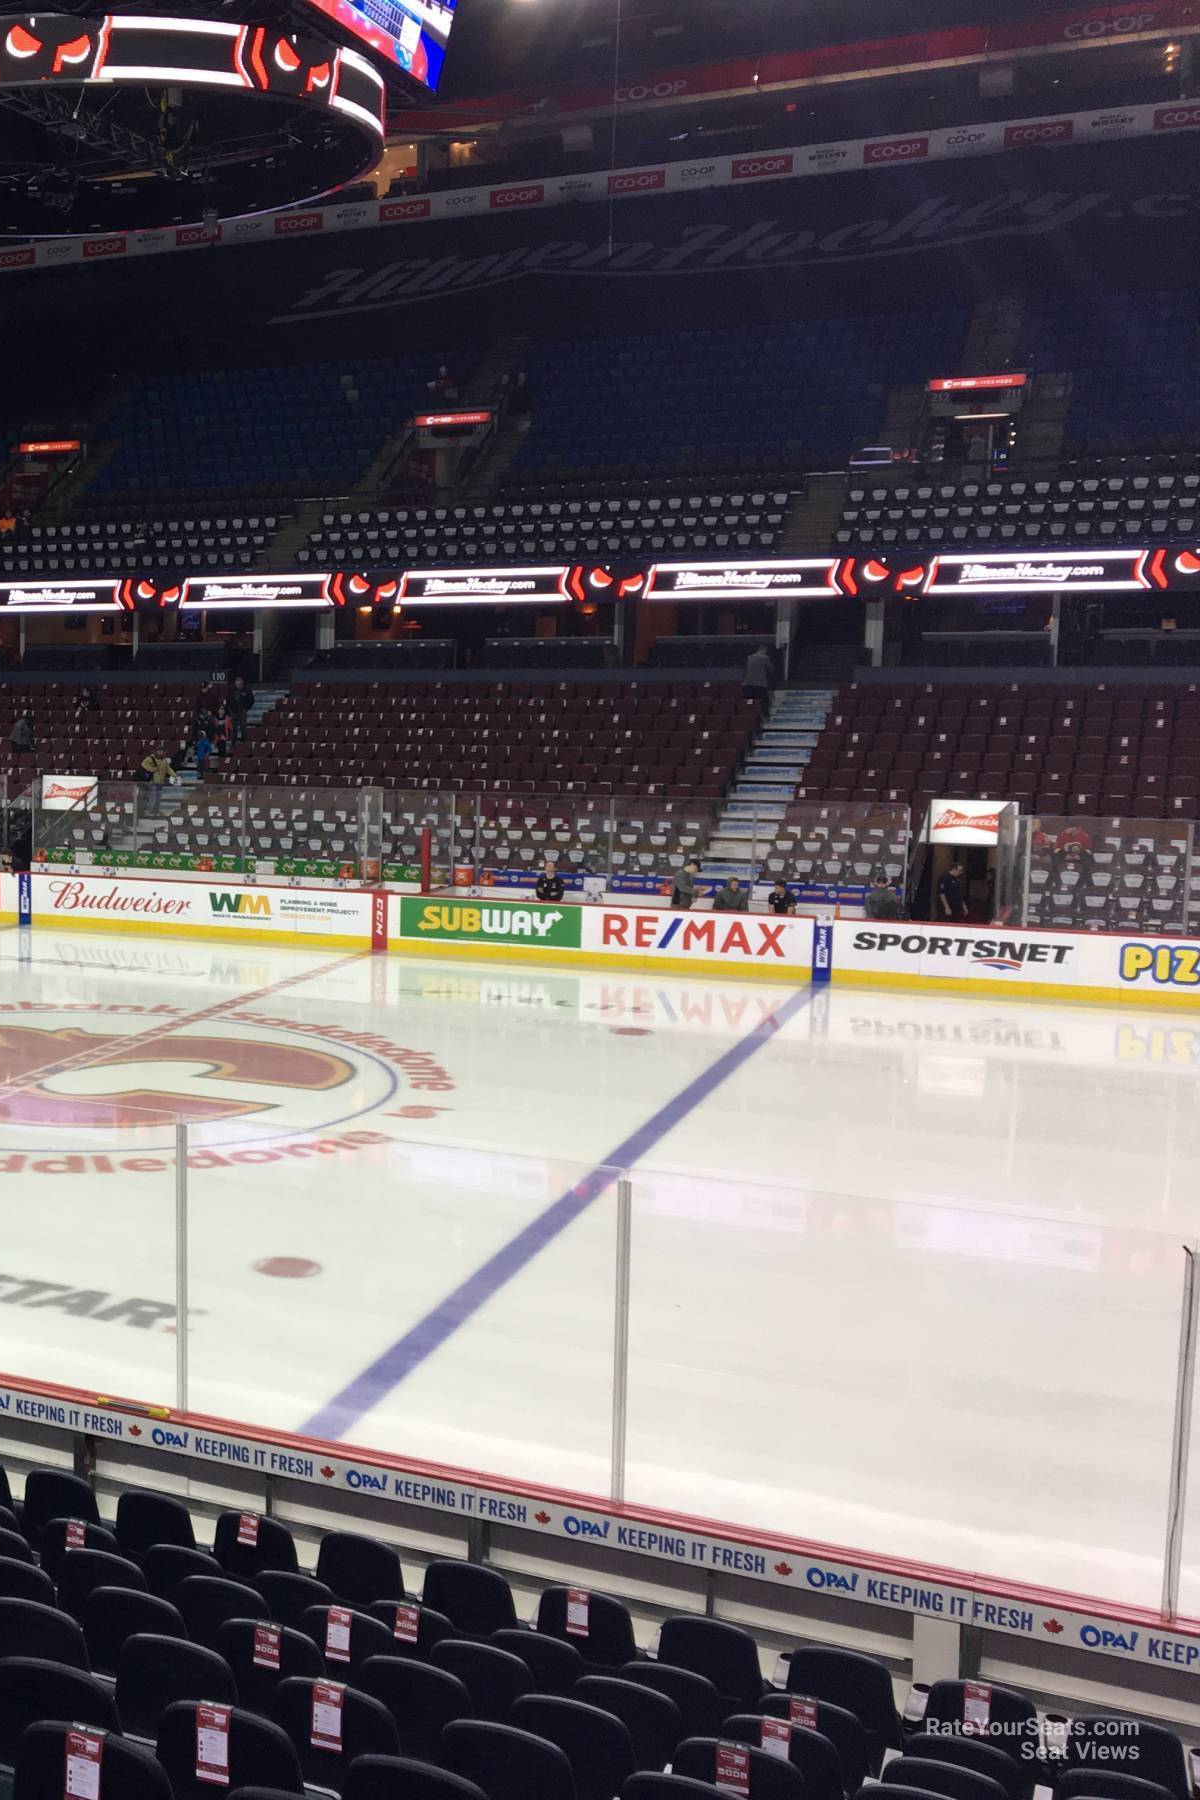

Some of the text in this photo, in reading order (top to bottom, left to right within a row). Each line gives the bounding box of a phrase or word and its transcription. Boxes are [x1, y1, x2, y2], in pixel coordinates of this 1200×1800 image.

[1063, 13, 1153, 39] CO-OP
[613, 79, 687, 102] CO-OP
[1011, 126, 1066, 142] CO-OP
[870, 142, 921, 158] CO-OP
[614, 174, 658, 190] CO-OP
[738, 159, 785, 175] CO-OP
[384, 203, 425, 218] CO-OP
[495, 188, 538, 204] CO-OP
[279, 217, 317, 231] CO-OP
[0, 252, 32, 266] CO-OP
[86, 239, 122, 254] CO-OP
[212, 671, 226, 682] 110
[48, 880, 192, 915] Budweiser
[208, 891, 273, 916] WM
[280, 906, 325, 915] IMPROVEMENT
[375, 897, 384, 935] CCM
[416, 905, 564, 940] SUBWAY
[602, 913, 787, 958] RE/MAX
[815, 928, 828, 964] WINMAR
[852, 931, 1075, 967] SPORTSNET
[1119, 942, 1200, 986] PIZ
[224, 1010, 458, 1094] Saddledome
[15, 1398, 65, 1424] KEEPING
[68, 1409, 80, 1427] IT
[83, 1412, 123, 1437] FRESH
[150, 1427, 314, 1478] OPA! KEEPING IT FRESH
[345, 1469, 527, 1524] OPA! KEEPING IT FRESH
[562, 1515, 765, 1575] OPA! KEEPING IT FRESH
[805, 1566, 1033, 1632] OPA! KEEPING IT FRESH
[1079, 1624, 1200, 1667] OPA! KEEP
